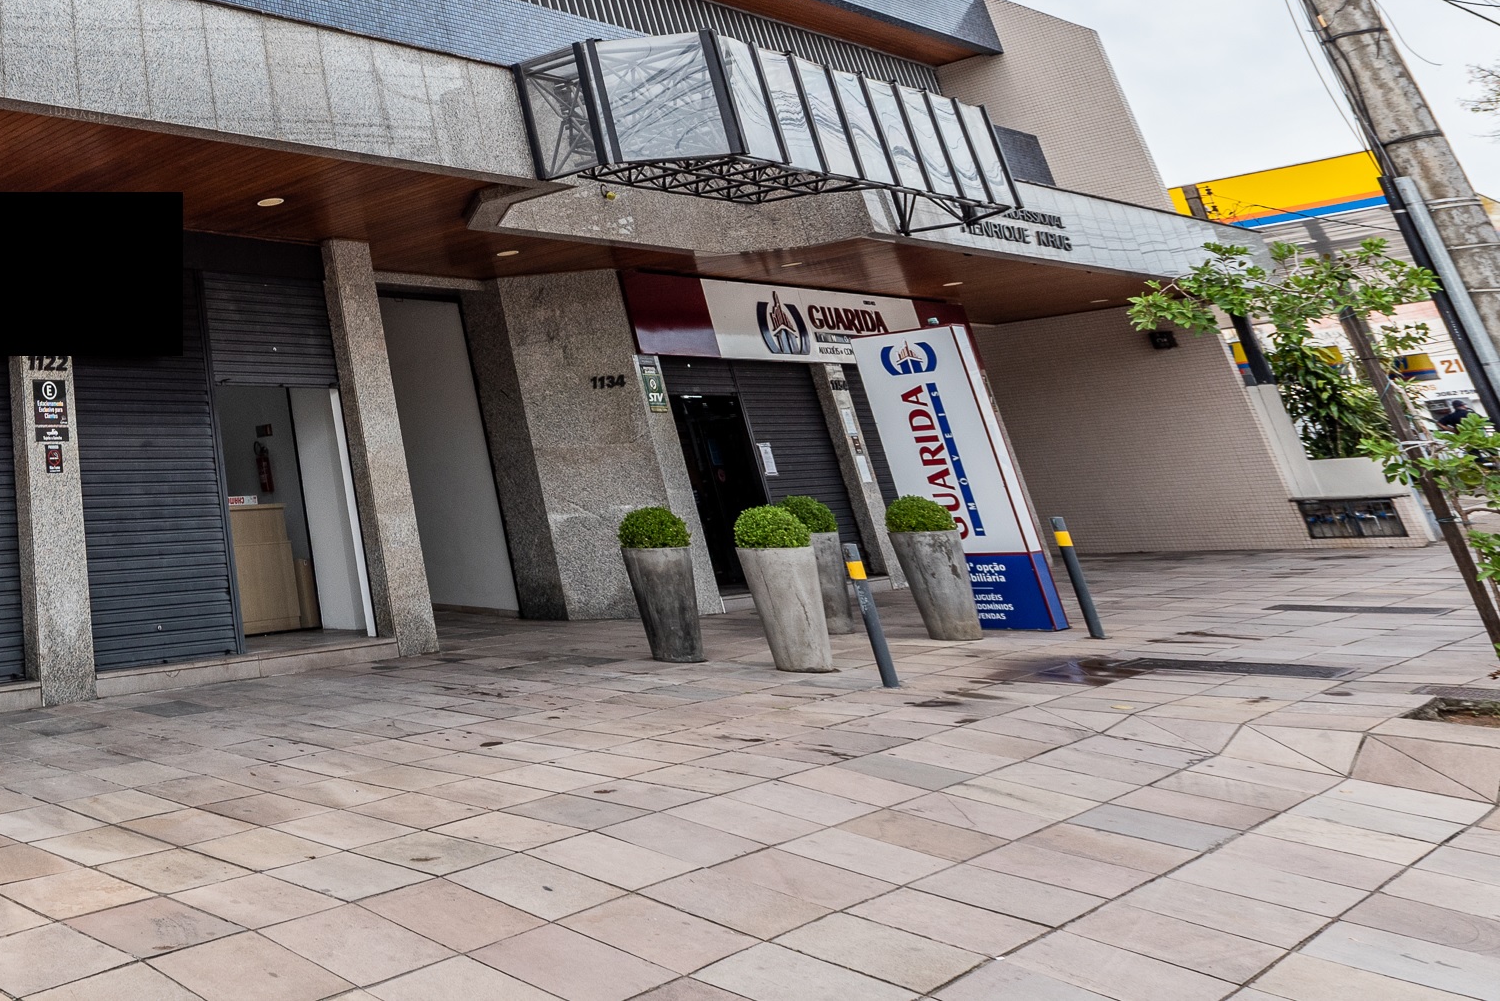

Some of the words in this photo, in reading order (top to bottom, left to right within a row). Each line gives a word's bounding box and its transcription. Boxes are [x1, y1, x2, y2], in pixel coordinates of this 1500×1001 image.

[1035, 230, 1072, 251] KRUG
[808, 304, 889, 334] GUARIDA
[590, 374, 626, 389] 1134
[649, 393, 663, 402] STV
[976, 562, 1006, 573] opção
[969, 573, 1006, 583] biliária
[976, 602, 1014, 611] DOMÍNIOS
